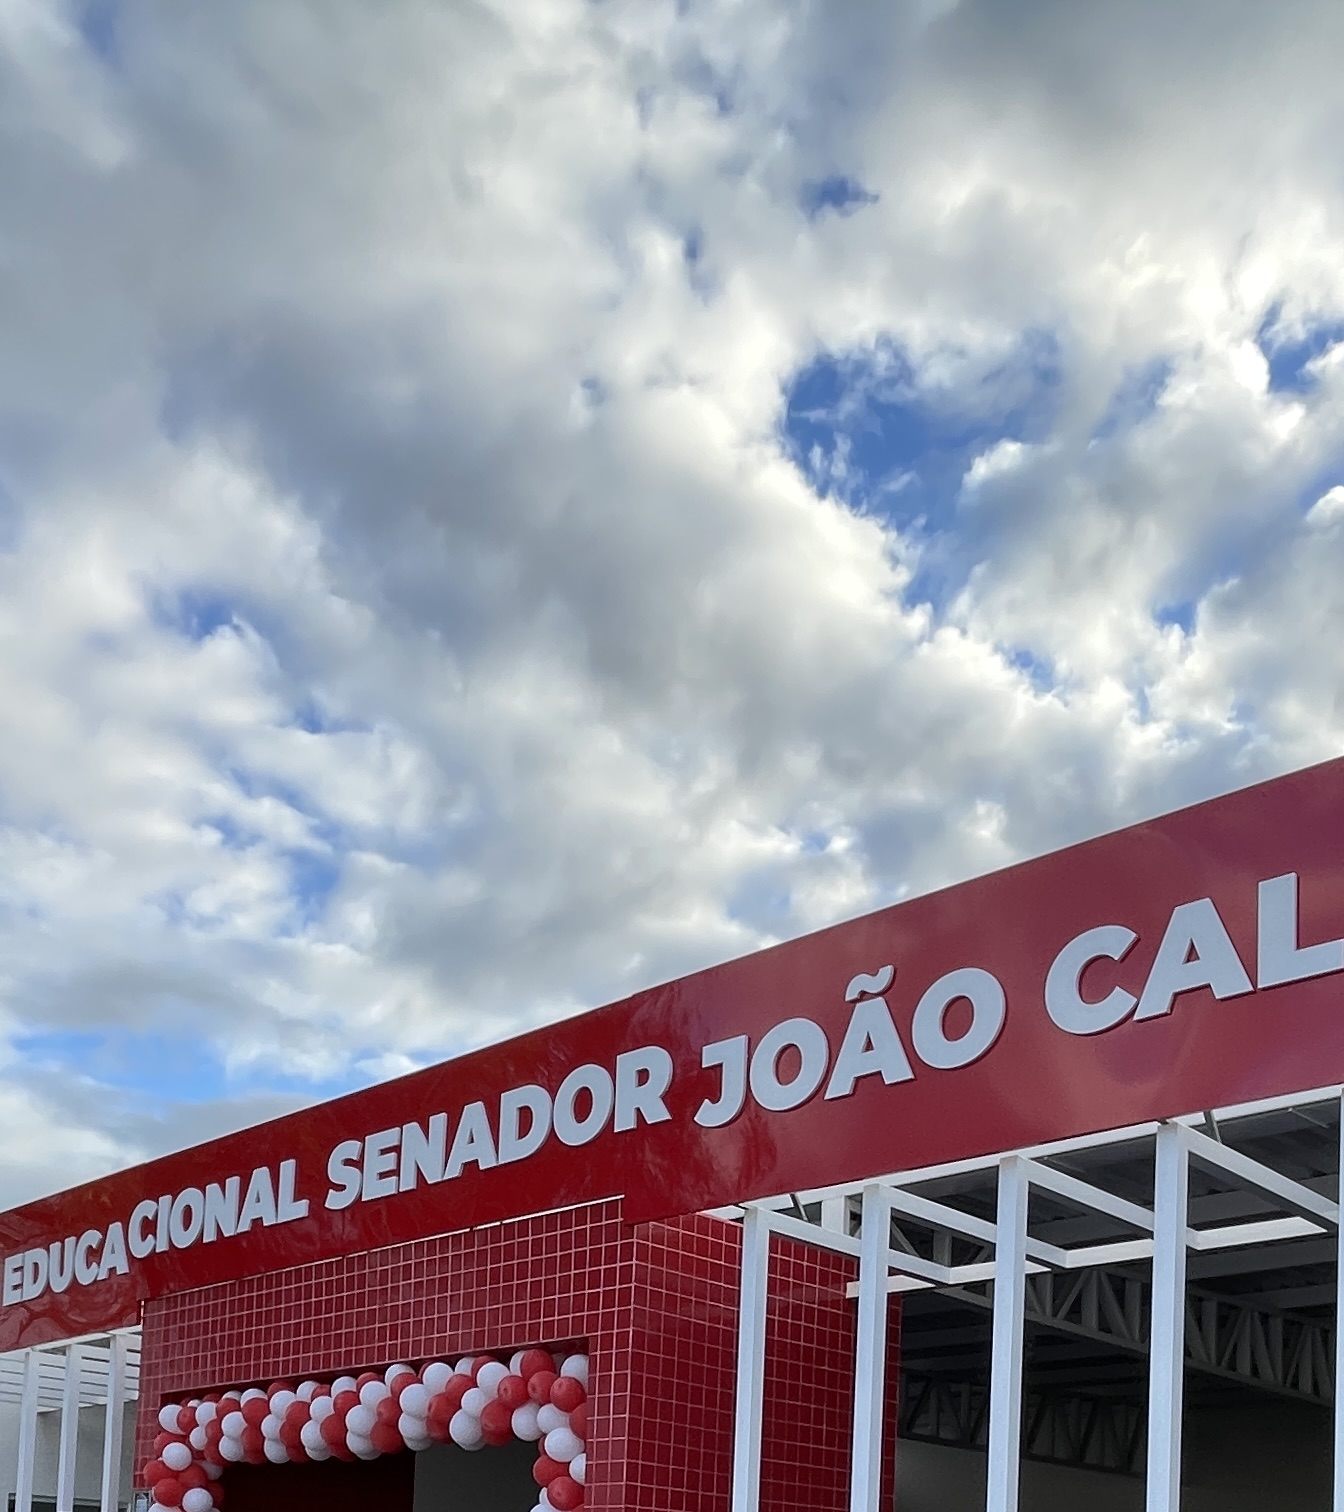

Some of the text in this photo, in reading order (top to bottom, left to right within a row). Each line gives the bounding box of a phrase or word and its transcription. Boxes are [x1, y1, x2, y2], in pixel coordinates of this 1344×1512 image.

[2, 1159, 310, 1307] EDUCACIONAL
[324, 1045, 674, 1210] SENADOR
[694, 964, 1007, 1128] JOÃO
